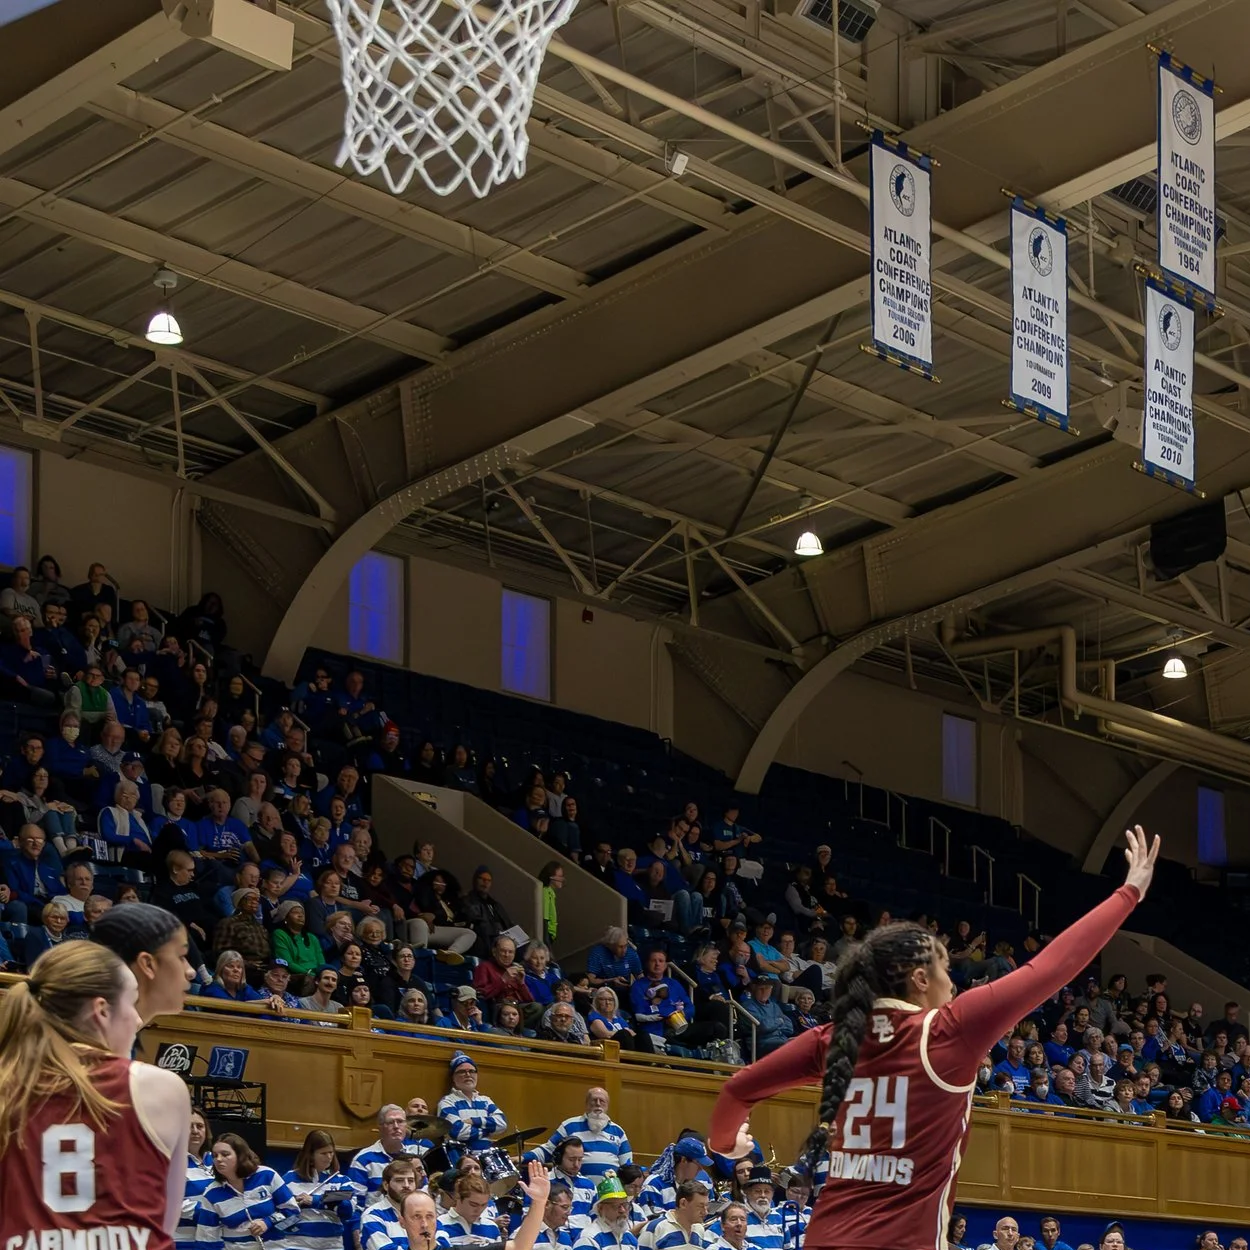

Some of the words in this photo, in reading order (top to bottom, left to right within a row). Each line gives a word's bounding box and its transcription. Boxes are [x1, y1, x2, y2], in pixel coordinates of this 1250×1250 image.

[1170, 151, 1206, 184] ATLANTIC
[1175, 172, 1200, 199] COAST
[1163, 183, 1213, 225] CONFERENCE
[1165, 203, 1211, 243] CHAMPIONS
[884, 226, 921, 257] ATLANTIC
[890, 249, 917, 271] COAST
[1178, 251, 1200, 275] 1964
[877, 259, 930, 296] CONFERENCE
[879, 278, 929, 313] CHAMPIONS
[1022, 286, 1060, 314] ATLANTIC
[1030, 306, 1055, 328] COAST
[893, 325, 915, 347] 2006
[1015, 317, 1065, 352] CONFERENCE
[1016, 336, 1064, 368] CHAMPIONS
[1154, 358, 1187, 386] ATLANTIC
[1031, 378, 1052, 399] 2009
[1148, 388, 1192, 421] CONFERENCE
[1150, 404, 1191, 436] CHAMPIONS
[1160, 446, 1182, 466] 2010
[348, 1075, 374, 1106] 17
[843, 1076, 909, 1149] 24
[42, 1123, 96, 1213] 8
